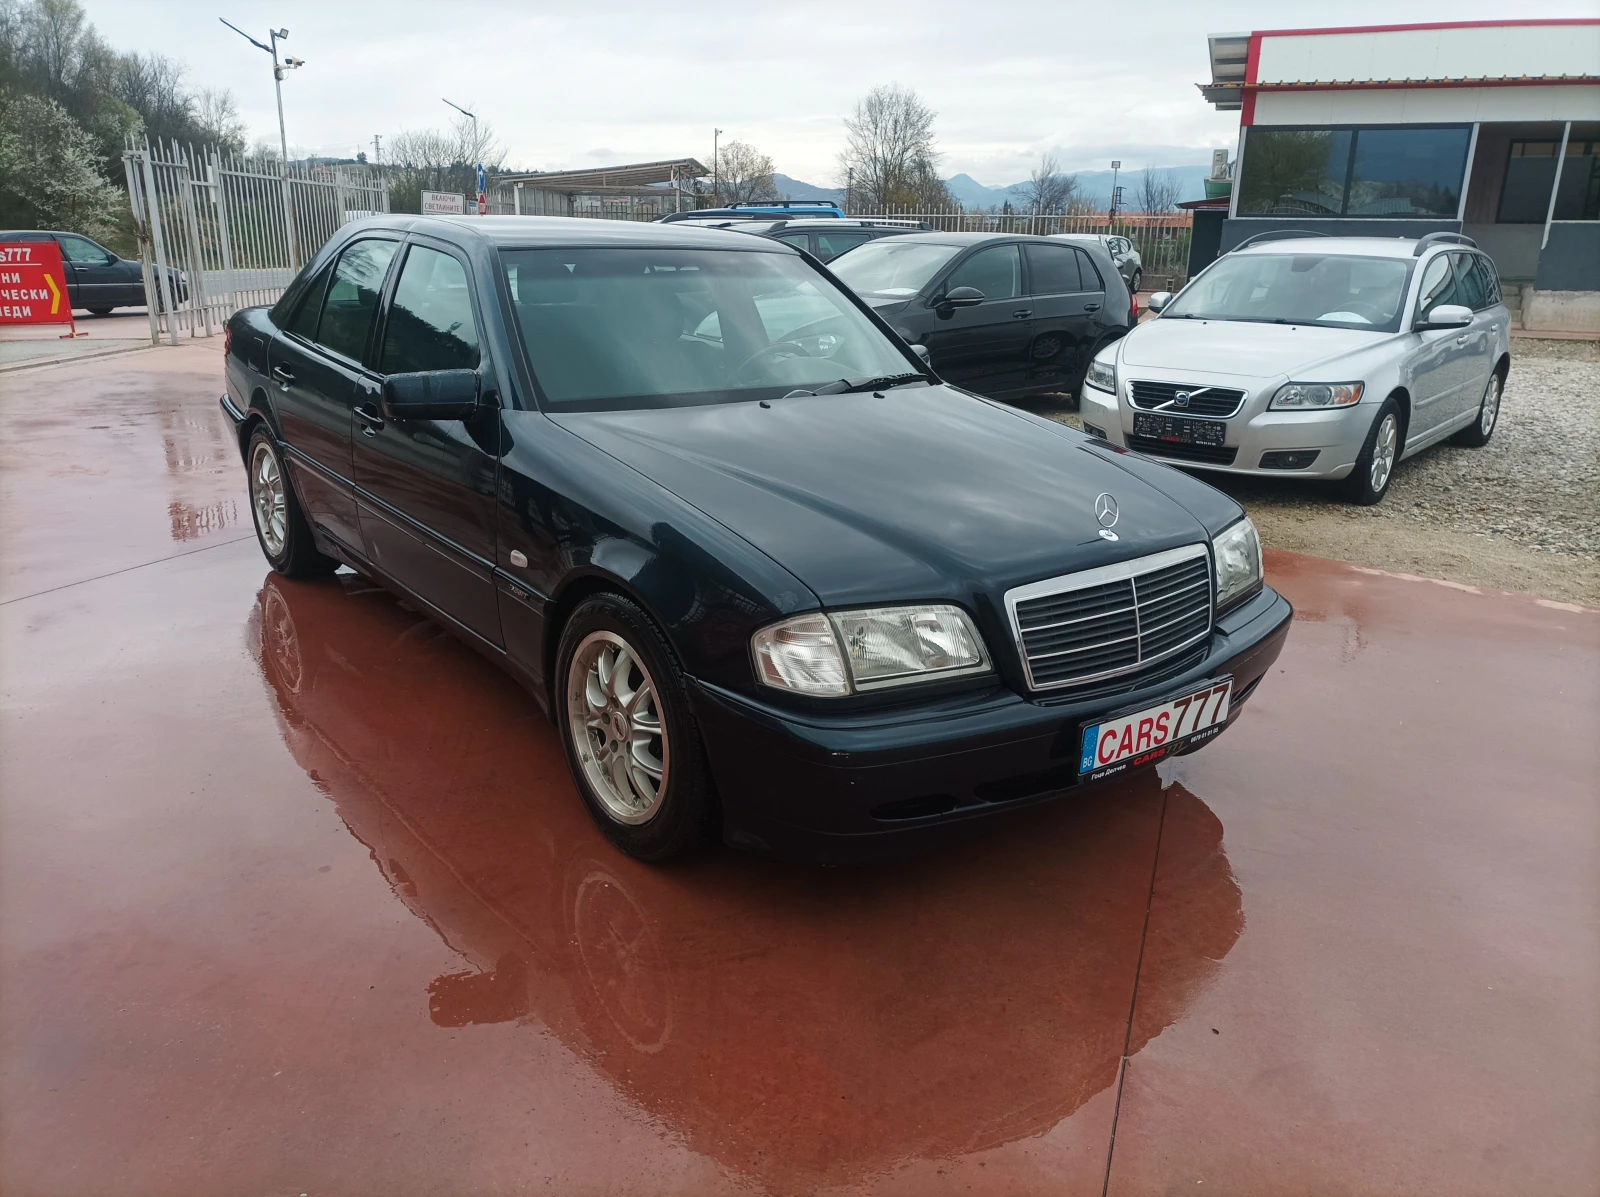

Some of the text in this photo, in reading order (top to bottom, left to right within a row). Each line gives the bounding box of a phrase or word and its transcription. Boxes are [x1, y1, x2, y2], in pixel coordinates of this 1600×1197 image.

[431, 194, 456, 202] ВКЛЮЧИ
[1, 273, 21, 283] НИ
[1, 289, 49, 300] ЧЕСКИ
[1082, 756, 1093, 768] BG
